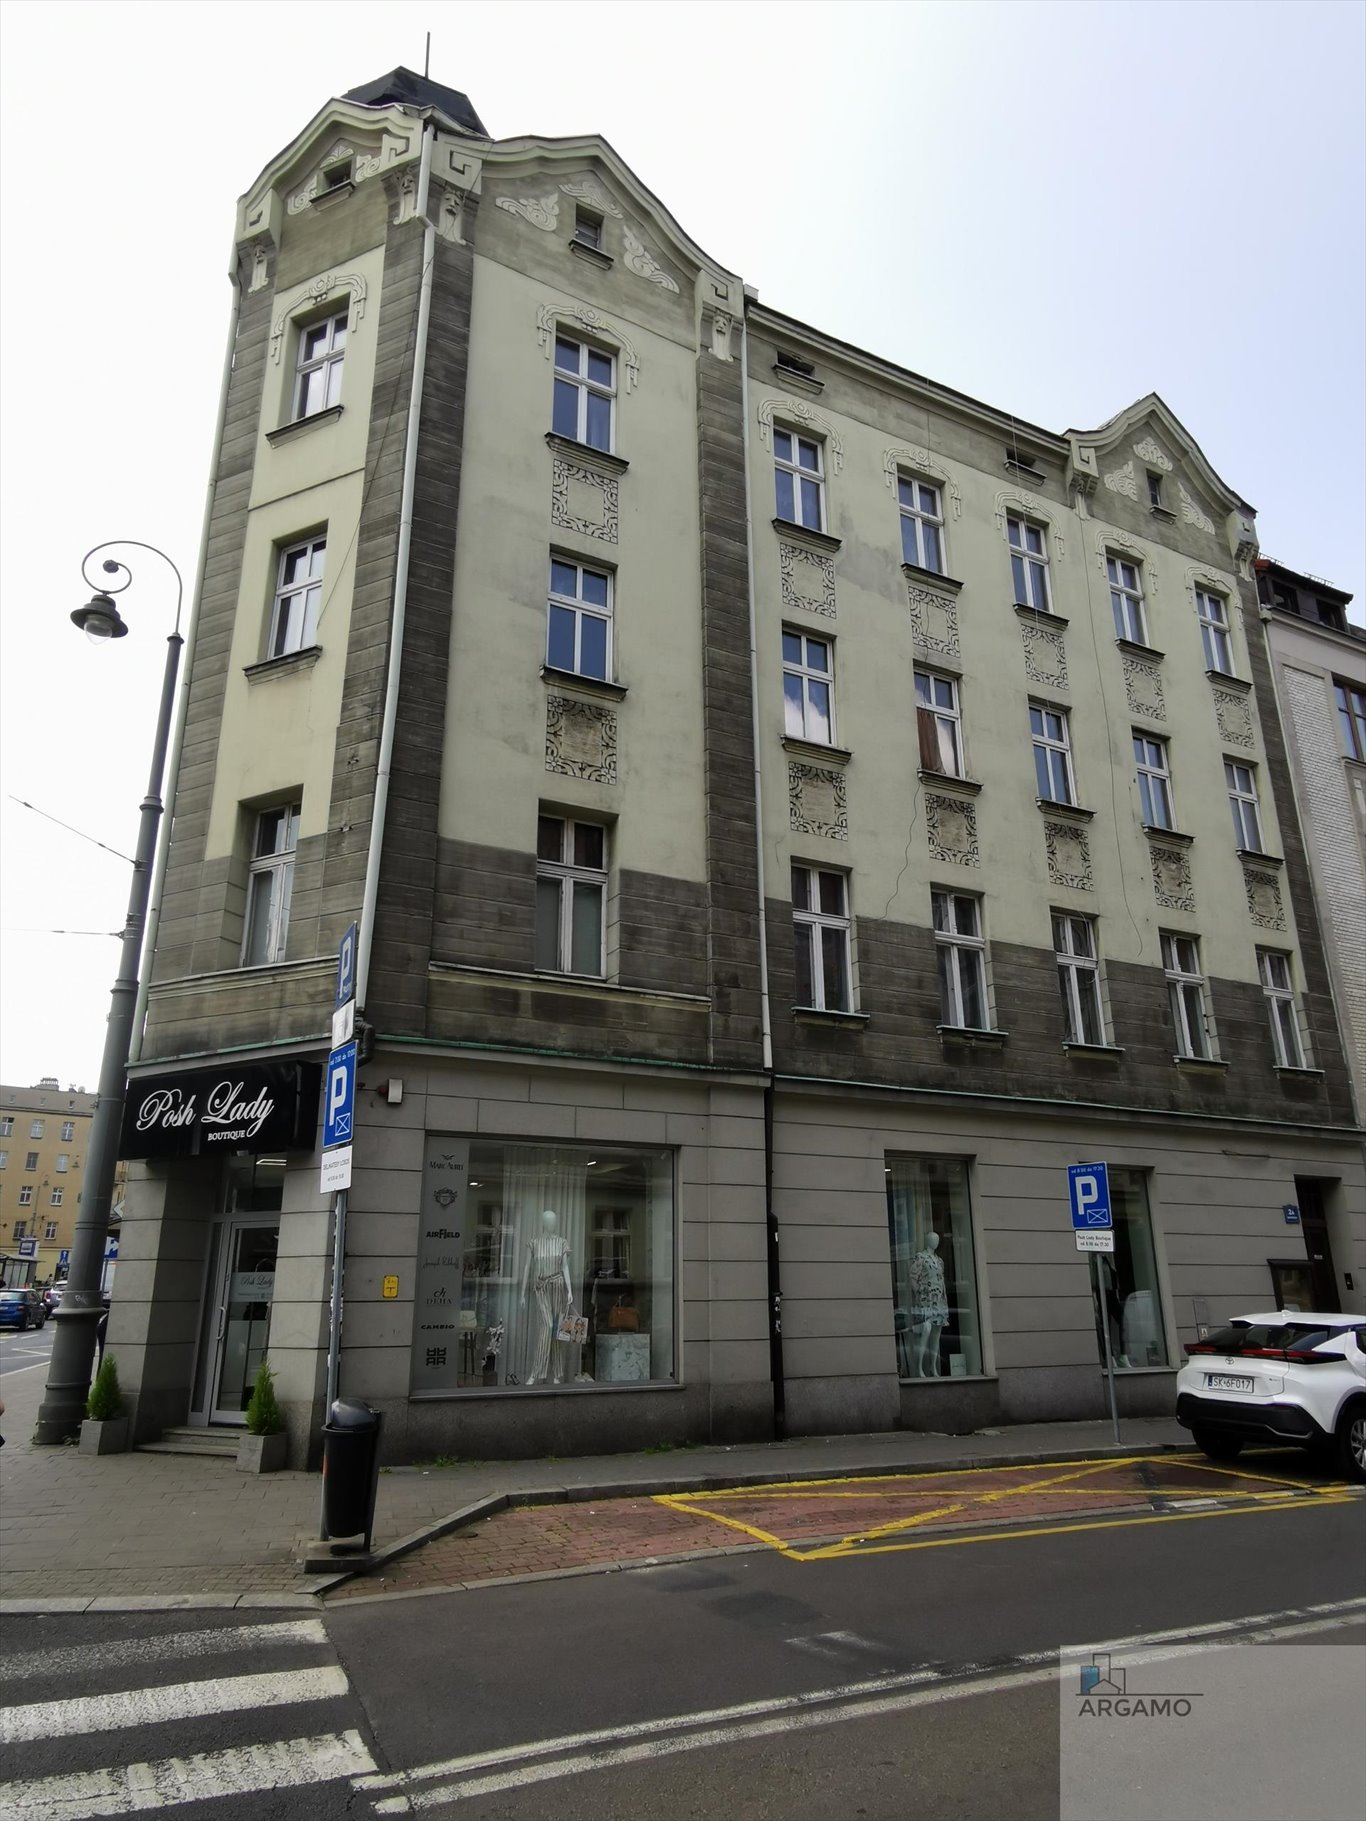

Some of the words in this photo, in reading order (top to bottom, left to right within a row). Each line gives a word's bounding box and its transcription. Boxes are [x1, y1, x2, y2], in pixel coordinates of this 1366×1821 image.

[340, 936, 351, 999] P
[136, 1088, 197, 1131] Posh
[200, 1081, 275, 1138] Lady
[330, 1065, 347, 1126] P
[207, 1129, 246, 1141] BOUTIQUE
[1075, 1176, 1098, 1215] P
[1213, 1376, 1223, 1387] SK
[1226, 1378, 1251, 1389] 6F017
